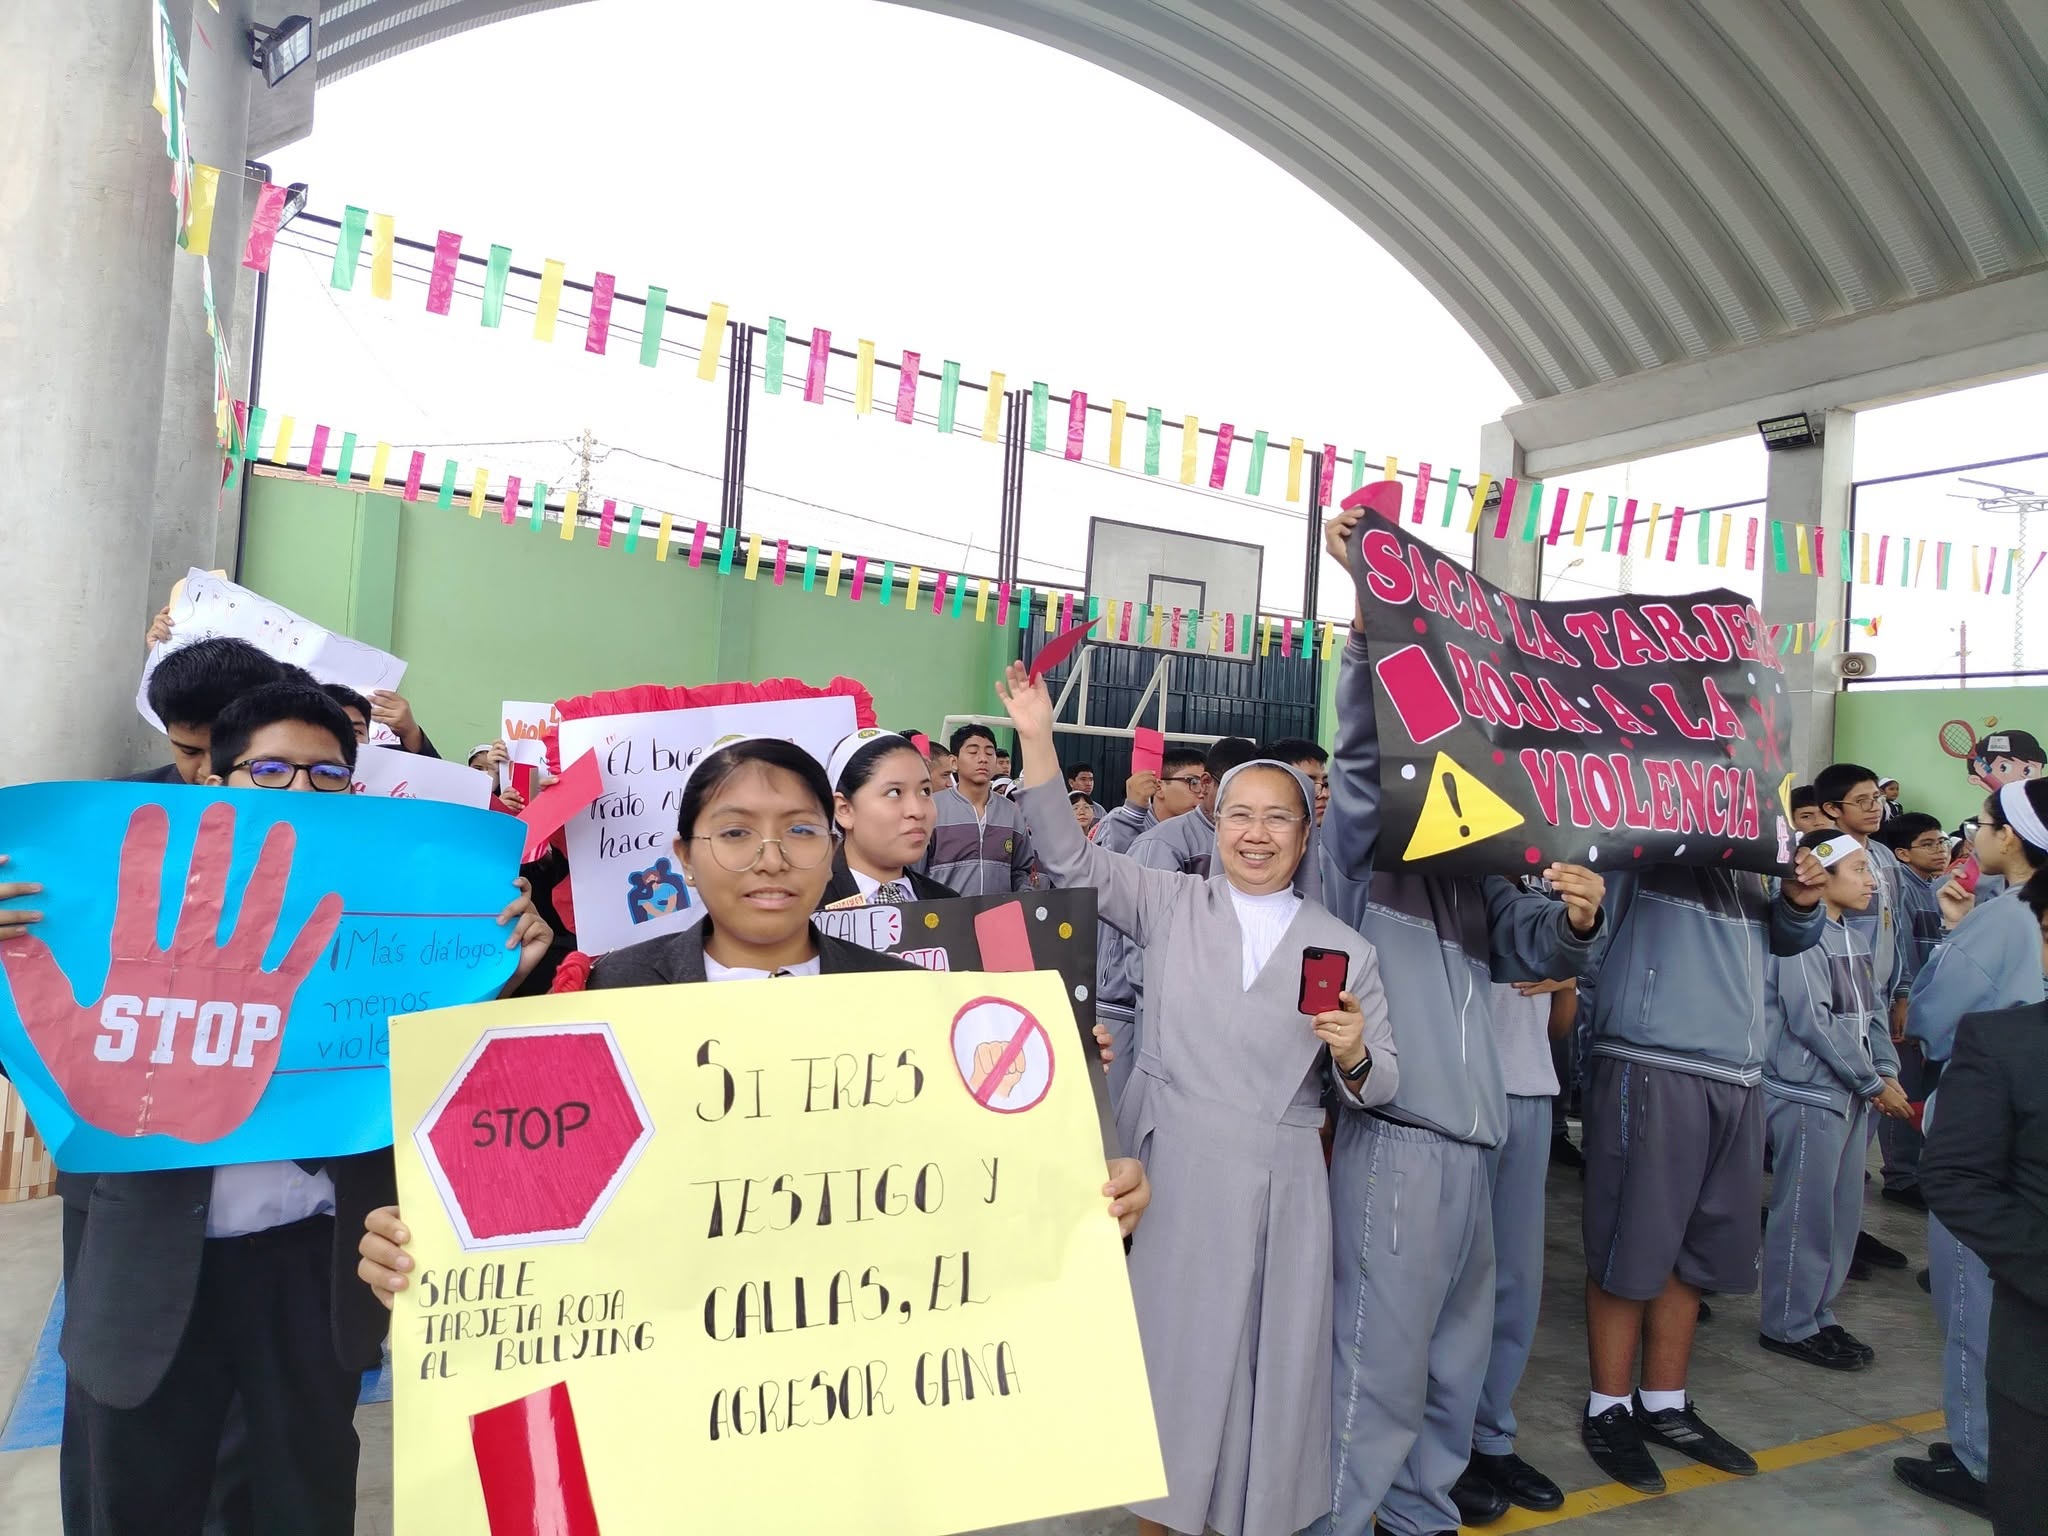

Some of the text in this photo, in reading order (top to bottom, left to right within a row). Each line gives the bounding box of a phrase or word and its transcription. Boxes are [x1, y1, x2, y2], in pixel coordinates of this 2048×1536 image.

[1362, 529, 1503, 644] SACA
[1500, 591, 1581, 668] LA
[1446, 642, 1745, 740] ROJA A LA
[1520, 748, 1759, 840] VIOLENCIA
[600, 827, 664, 859] hace
[93, 994, 281, 1068] STOP
[324, 991, 431, 1022] menos
[791, 1048, 925, 1113] ERES
[472, 1101, 591, 1150] STOP
[689, 1162, 944, 1239] TESTIGO
[418, 1289, 625, 1344] TARJETA ROJA
[419, 1261, 535, 1308] SACALE
[704, 1251, 991, 1341] CALLAS, EL
[420, 1321, 655, 1380] AL BULLYING
[710, 1341, 1021, 1441] AGRESOR GANA
